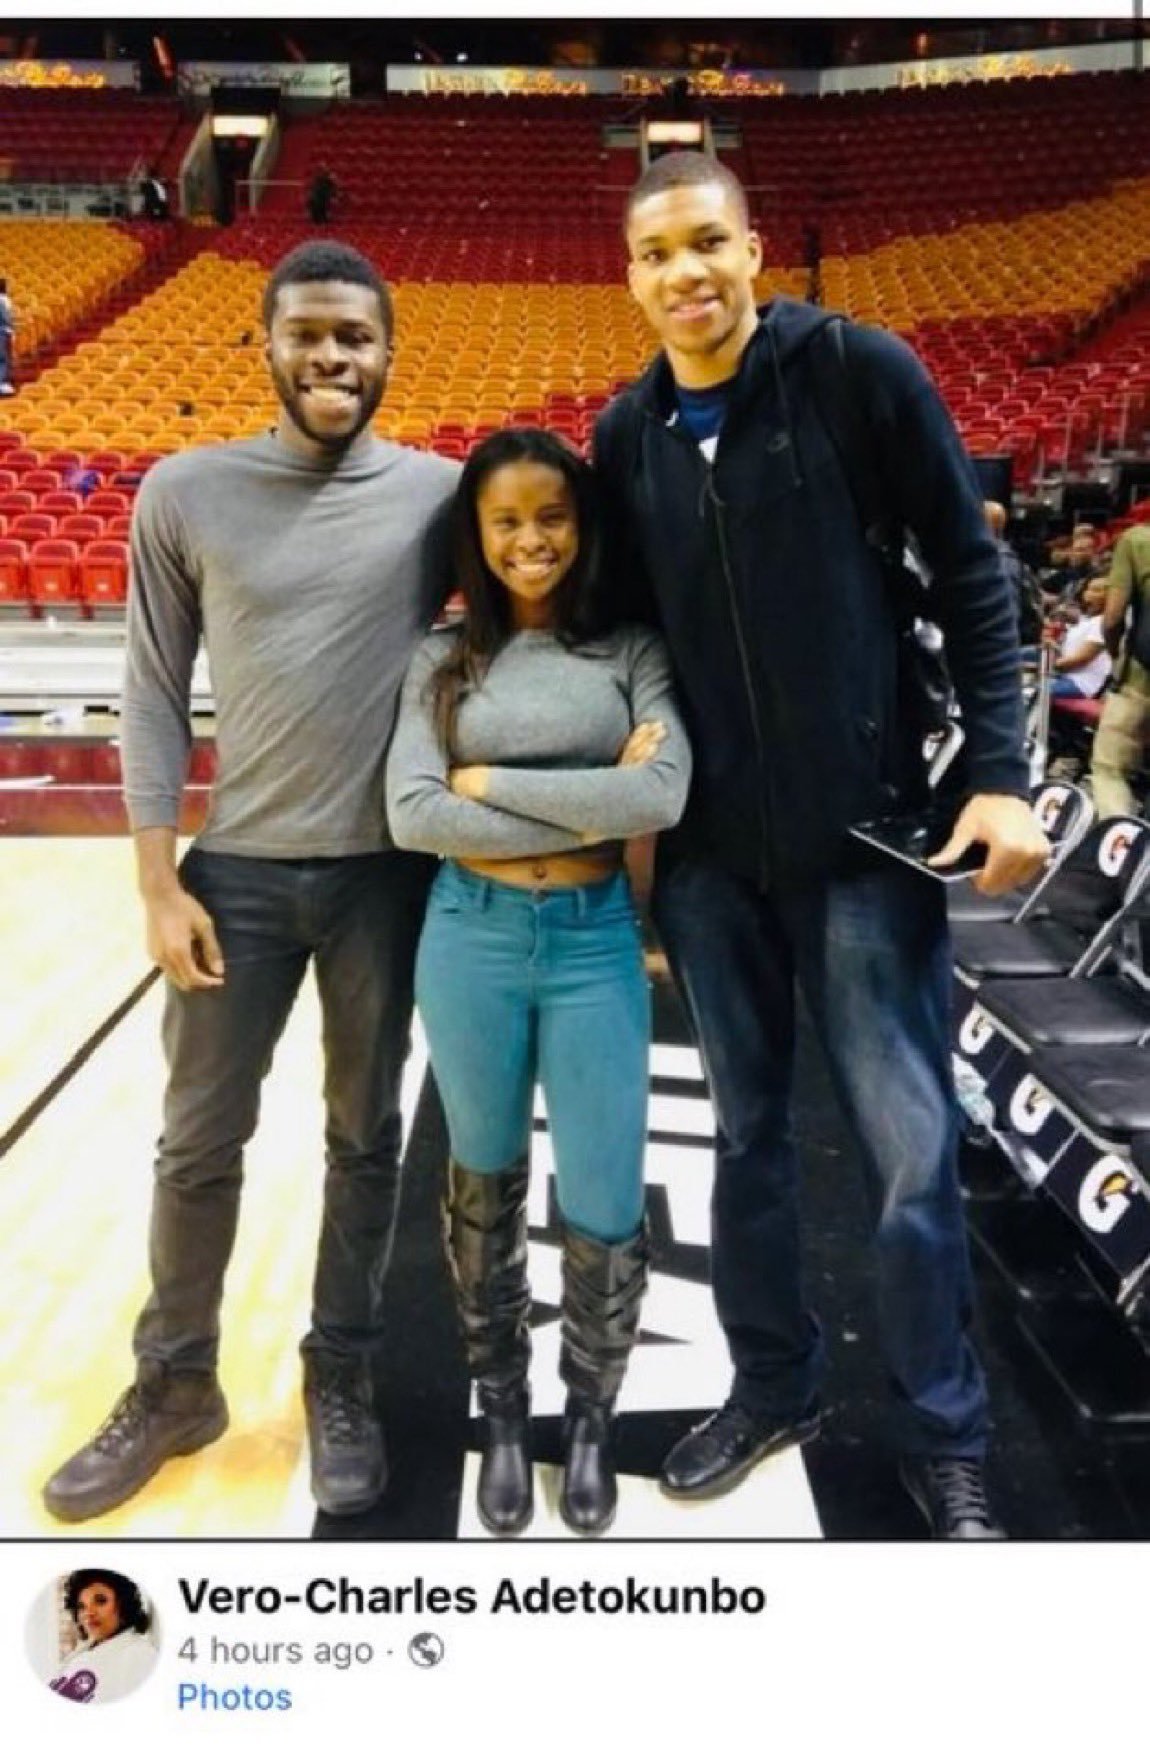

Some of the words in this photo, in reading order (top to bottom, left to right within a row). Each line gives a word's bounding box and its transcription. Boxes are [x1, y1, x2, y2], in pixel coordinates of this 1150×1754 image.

[1099, 822, 1144, 877] G
[1010, 1073, 1056, 1136] G
[1079, 1155, 1133, 1233] G
